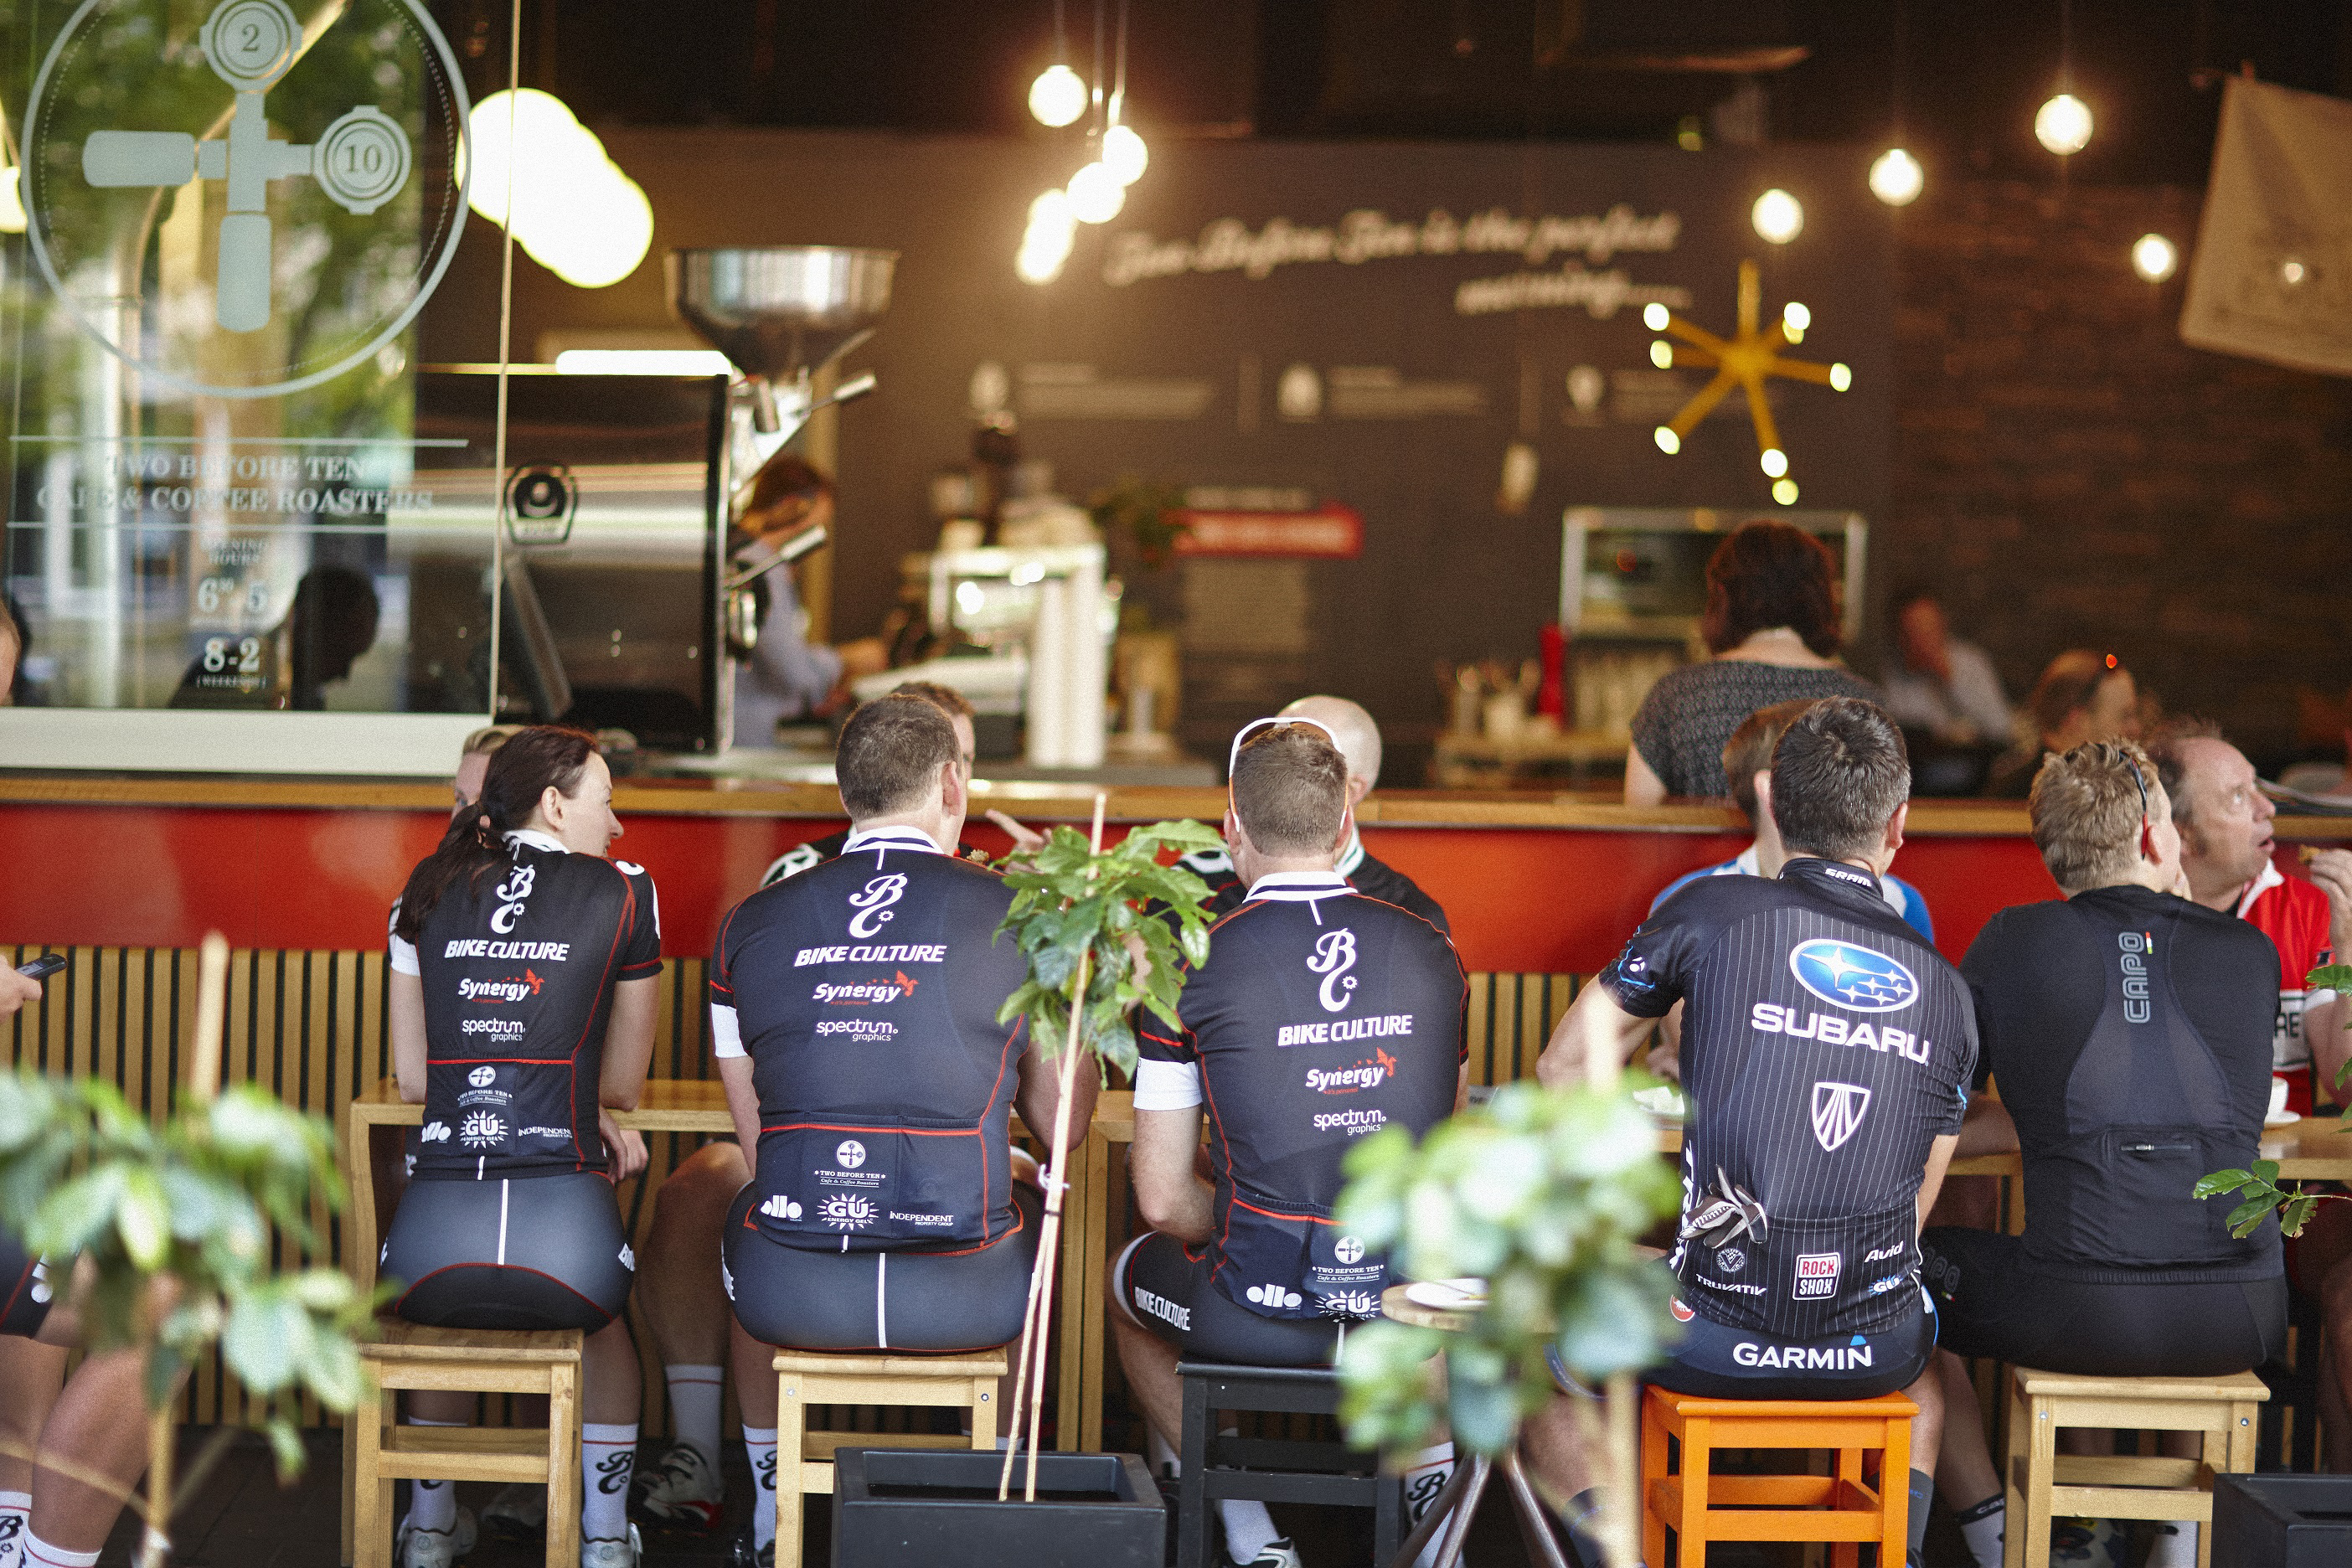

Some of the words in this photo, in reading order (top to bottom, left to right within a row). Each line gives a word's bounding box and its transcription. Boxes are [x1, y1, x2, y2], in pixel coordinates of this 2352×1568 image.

[241, 23, 260, 52] 2
[345, 144, 382, 173] 10
[304, 456, 364, 482] TEN
[149, 486, 269, 513] COFFEE
[276, 487, 434, 517] ROASTERS
[1824, 867, 1872, 888] SRAM
[444, 939, 489, 958] BIKE
[487, 941, 570, 962] CULTURE
[794, 946, 850, 967] BIKE
[848, 945, 947, 962] CULTURE
[457, 977, 530, 1002] Synergy
[2117, 931, 2151, 1024] CAPO
[812, 983, 902, 1003] Synergy
[491, 1032, 524, 1043] graphics
[852, 1034, 892, 1043] graphics
[1277, 1023, 1328, 1046] BIKE
[1330, 1014, 1413, 1042] CULTURE
[1751, 1003, 1930, 1065] SUBARU
[1305, 1066, 1385, 1092] Synergy
[1347, 1122, 1381, 1136] graphics
[890, 1210, 954, 1222] INDEPENDENT
[1864, 1240, 1904, 1263] Avid
[1801, 1259, 1835, 1276] ROCK
[1695, 1273, 1767, 1297] TRUVATIV
[1798, 1277, 1834, 1296] SHOX
[1154, 1296, 1191, 1332] CULTURE
[1732, 1342, 1873, 1370] GARMIN
